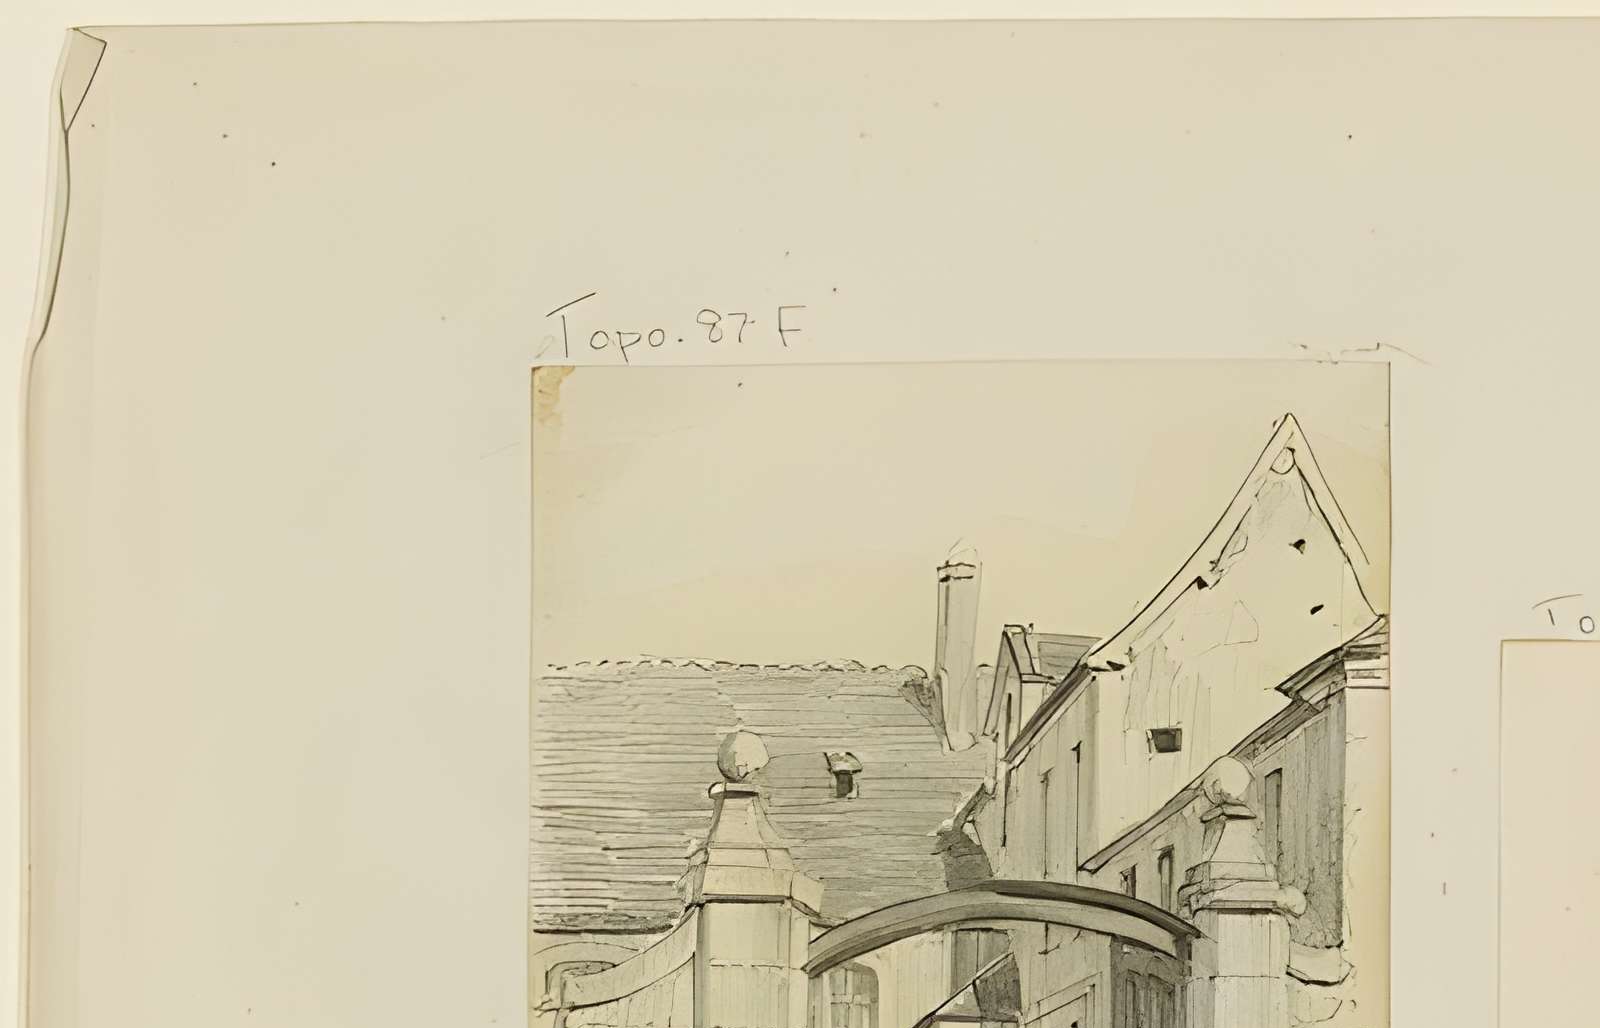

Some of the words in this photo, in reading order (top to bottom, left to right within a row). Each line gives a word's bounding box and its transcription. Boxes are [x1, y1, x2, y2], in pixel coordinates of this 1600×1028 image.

[546, 292, 684, 363] Topo.
[696, 308, 756, 343] 87
[777, 304, 807, 348] F
